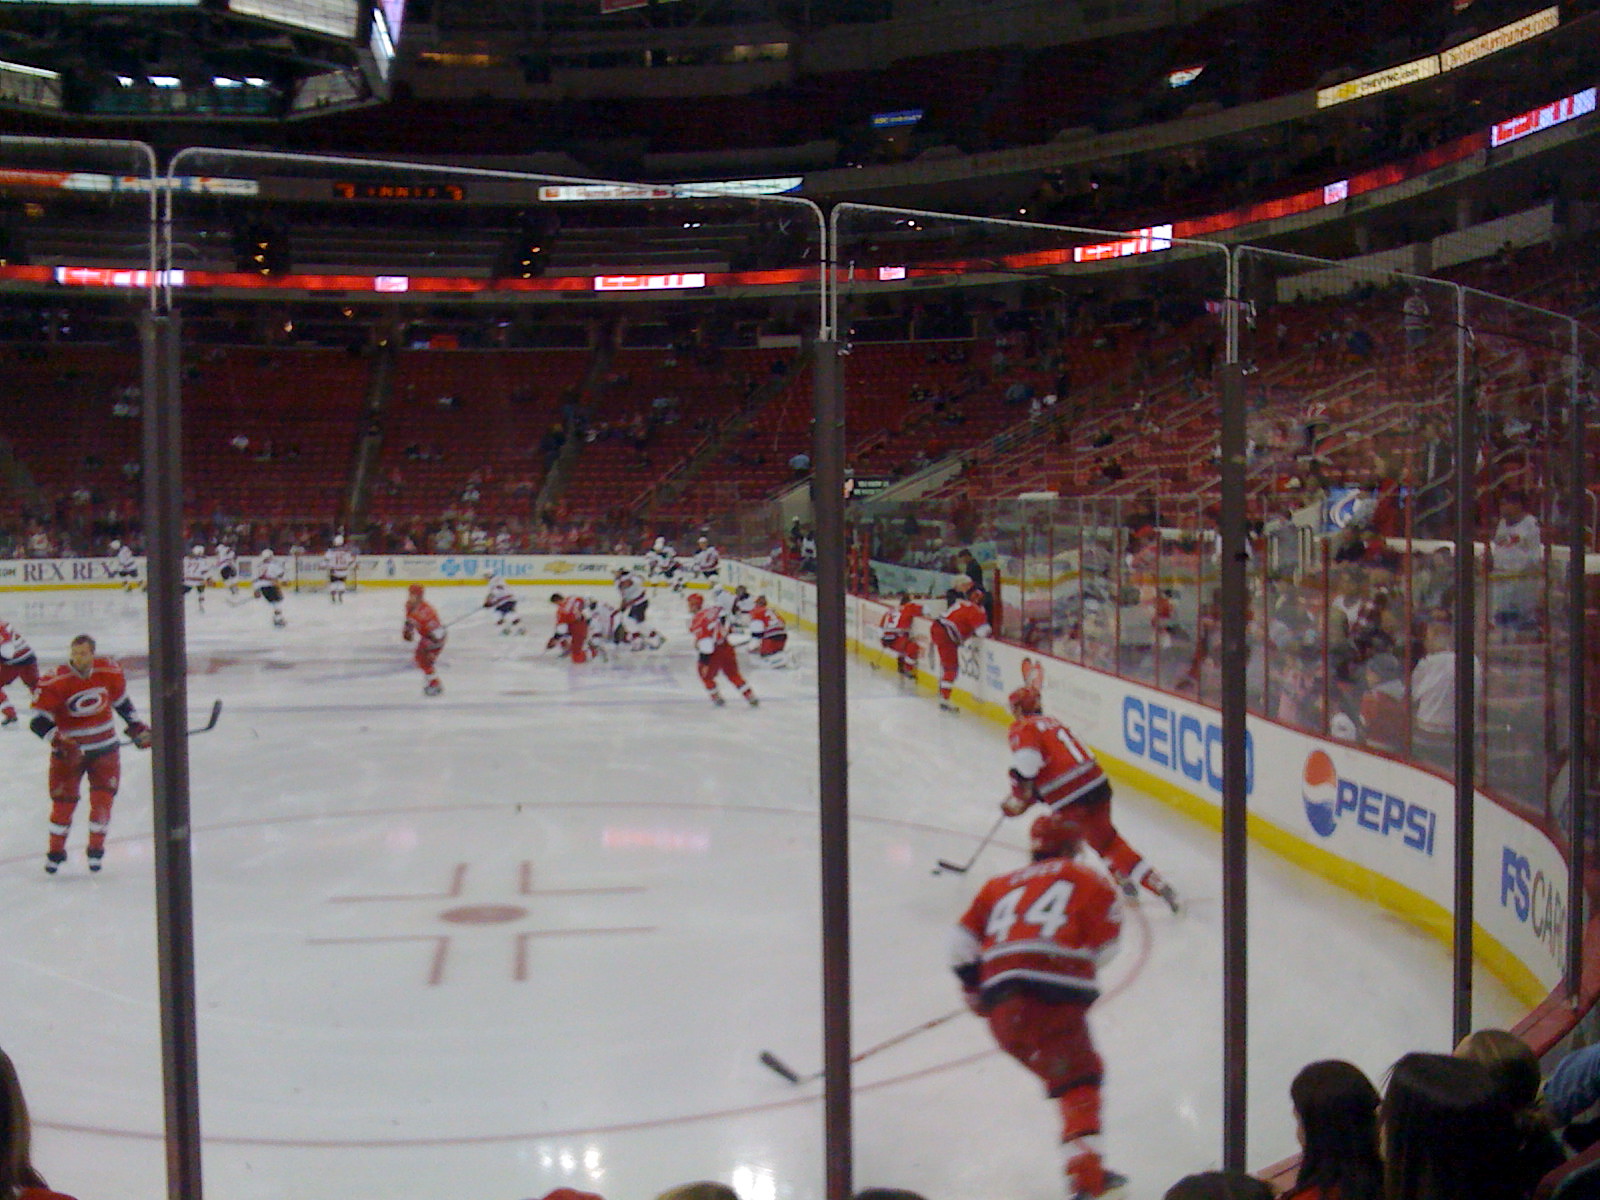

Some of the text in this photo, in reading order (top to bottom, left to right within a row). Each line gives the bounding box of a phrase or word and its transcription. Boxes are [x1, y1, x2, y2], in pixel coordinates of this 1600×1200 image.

[23, 562, 64, 581] REX
[1122, 695, 1254, 795] GEICO
[1335, 778, 1436, 856] PEPSI
[985, 879, 1075, 943] 44
